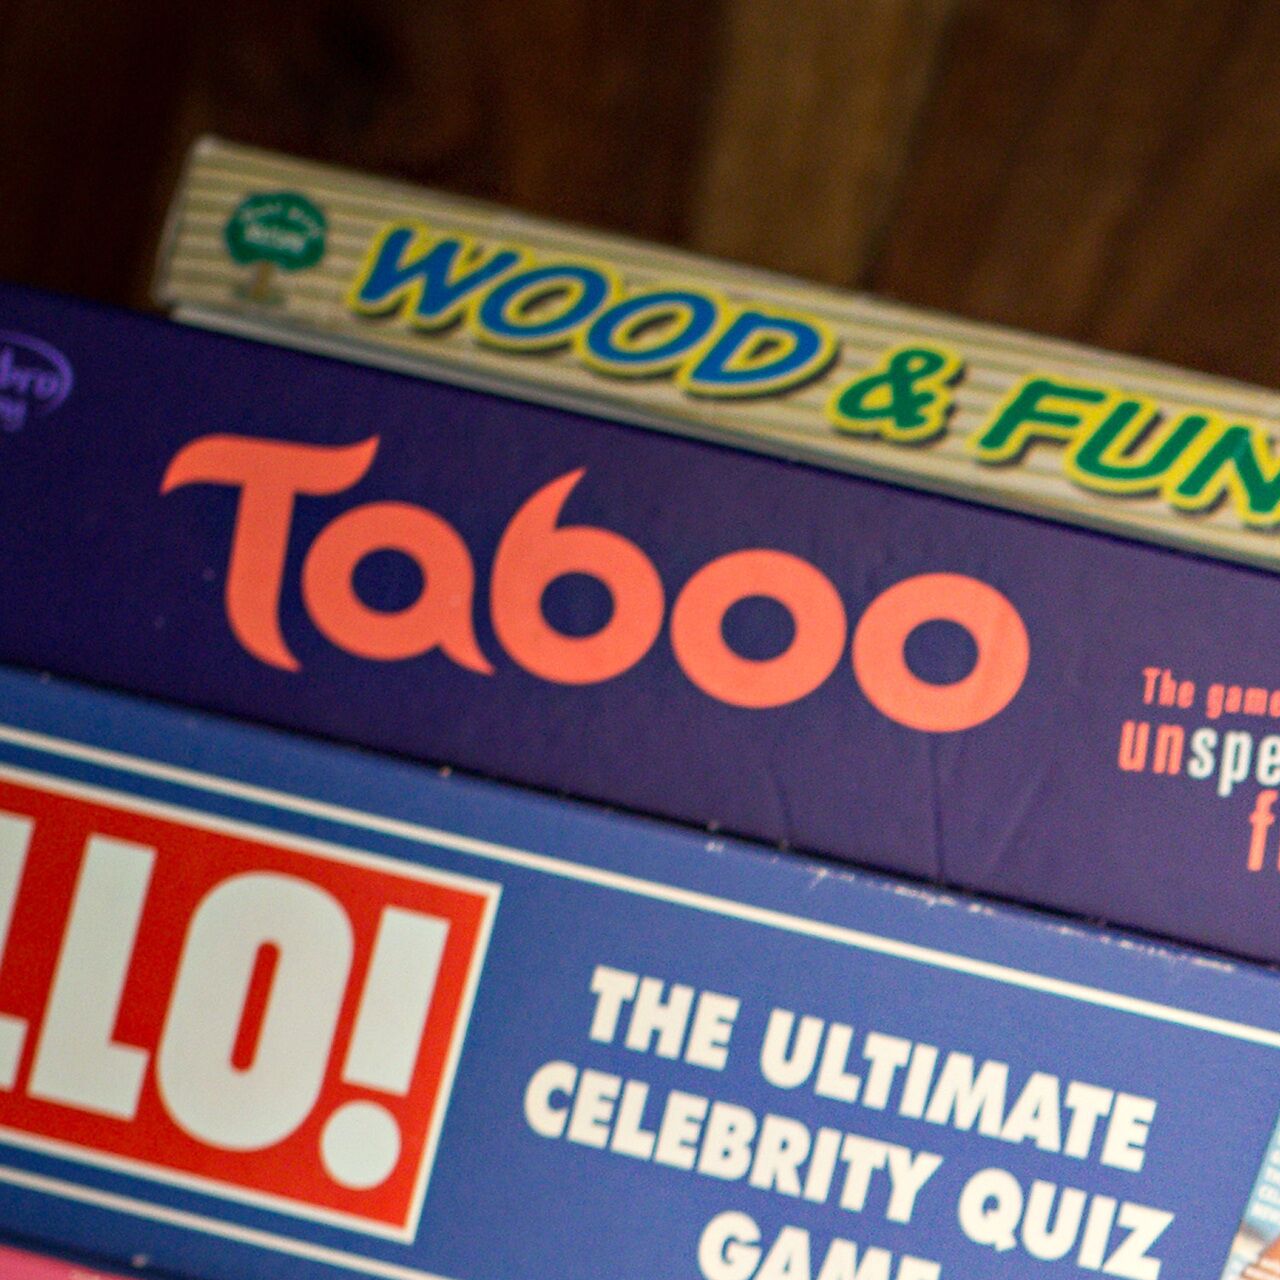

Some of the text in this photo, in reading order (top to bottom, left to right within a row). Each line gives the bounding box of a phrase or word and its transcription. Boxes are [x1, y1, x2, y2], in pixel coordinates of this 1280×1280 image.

[350, 224, 835, 394] WOOD
[830, 342, 957, 440] &
[160, 432, 1031, 734] Taboo
[1142, 667, 1194, 709] The
[0, 808, 452, 1192] LO!
[589, 964, 1157, 1173] THE ULTIMATE
[523, 1059, 943, 1224] CELEBRITY
